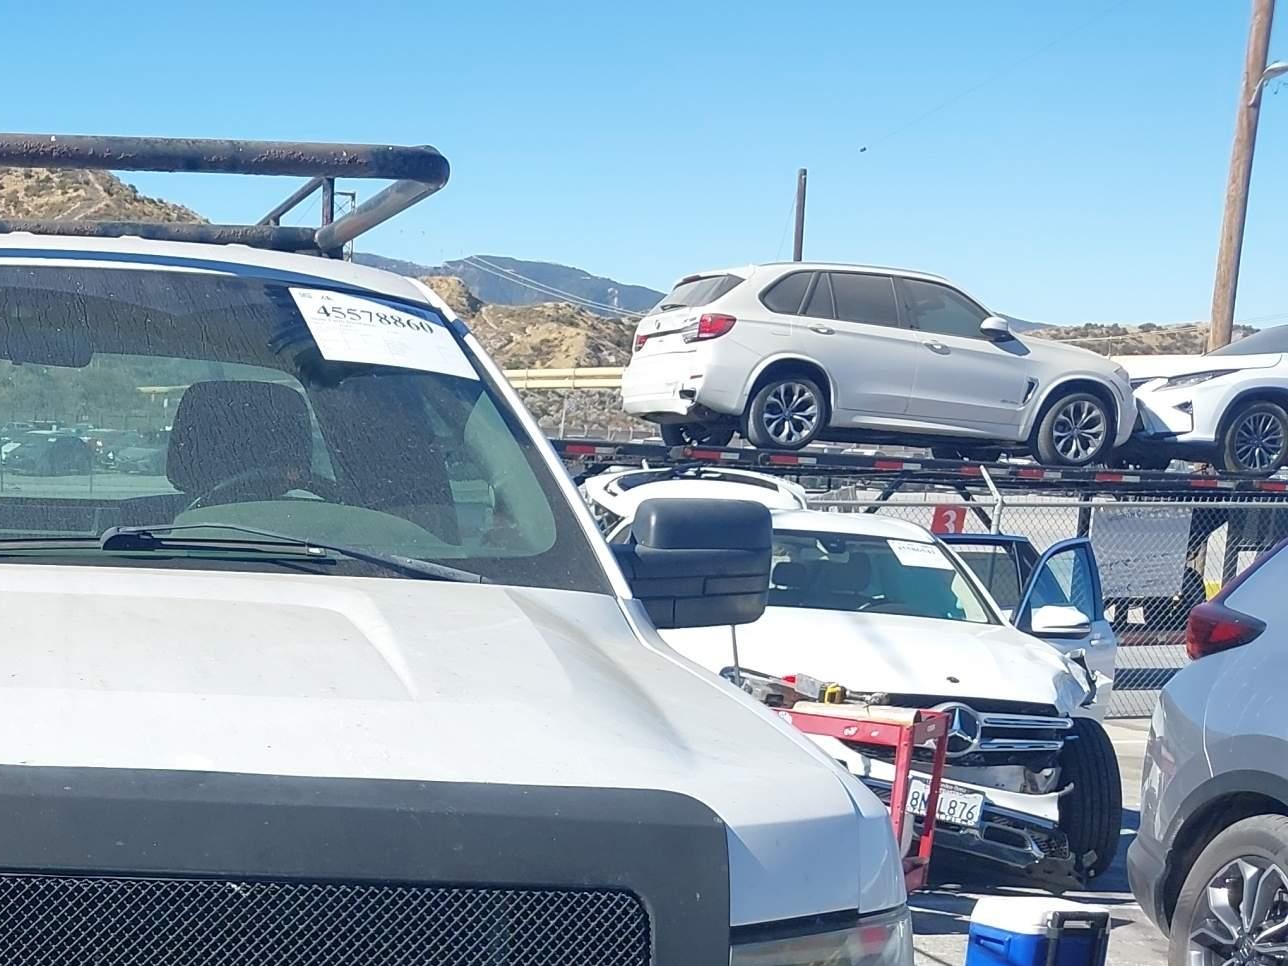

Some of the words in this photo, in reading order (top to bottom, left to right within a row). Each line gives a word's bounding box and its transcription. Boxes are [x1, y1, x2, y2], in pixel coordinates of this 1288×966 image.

[317, 305, 434, 334] 45578860
[942, 509, 957, 534] 3
[910, 790, 977, 821] 8ML876
